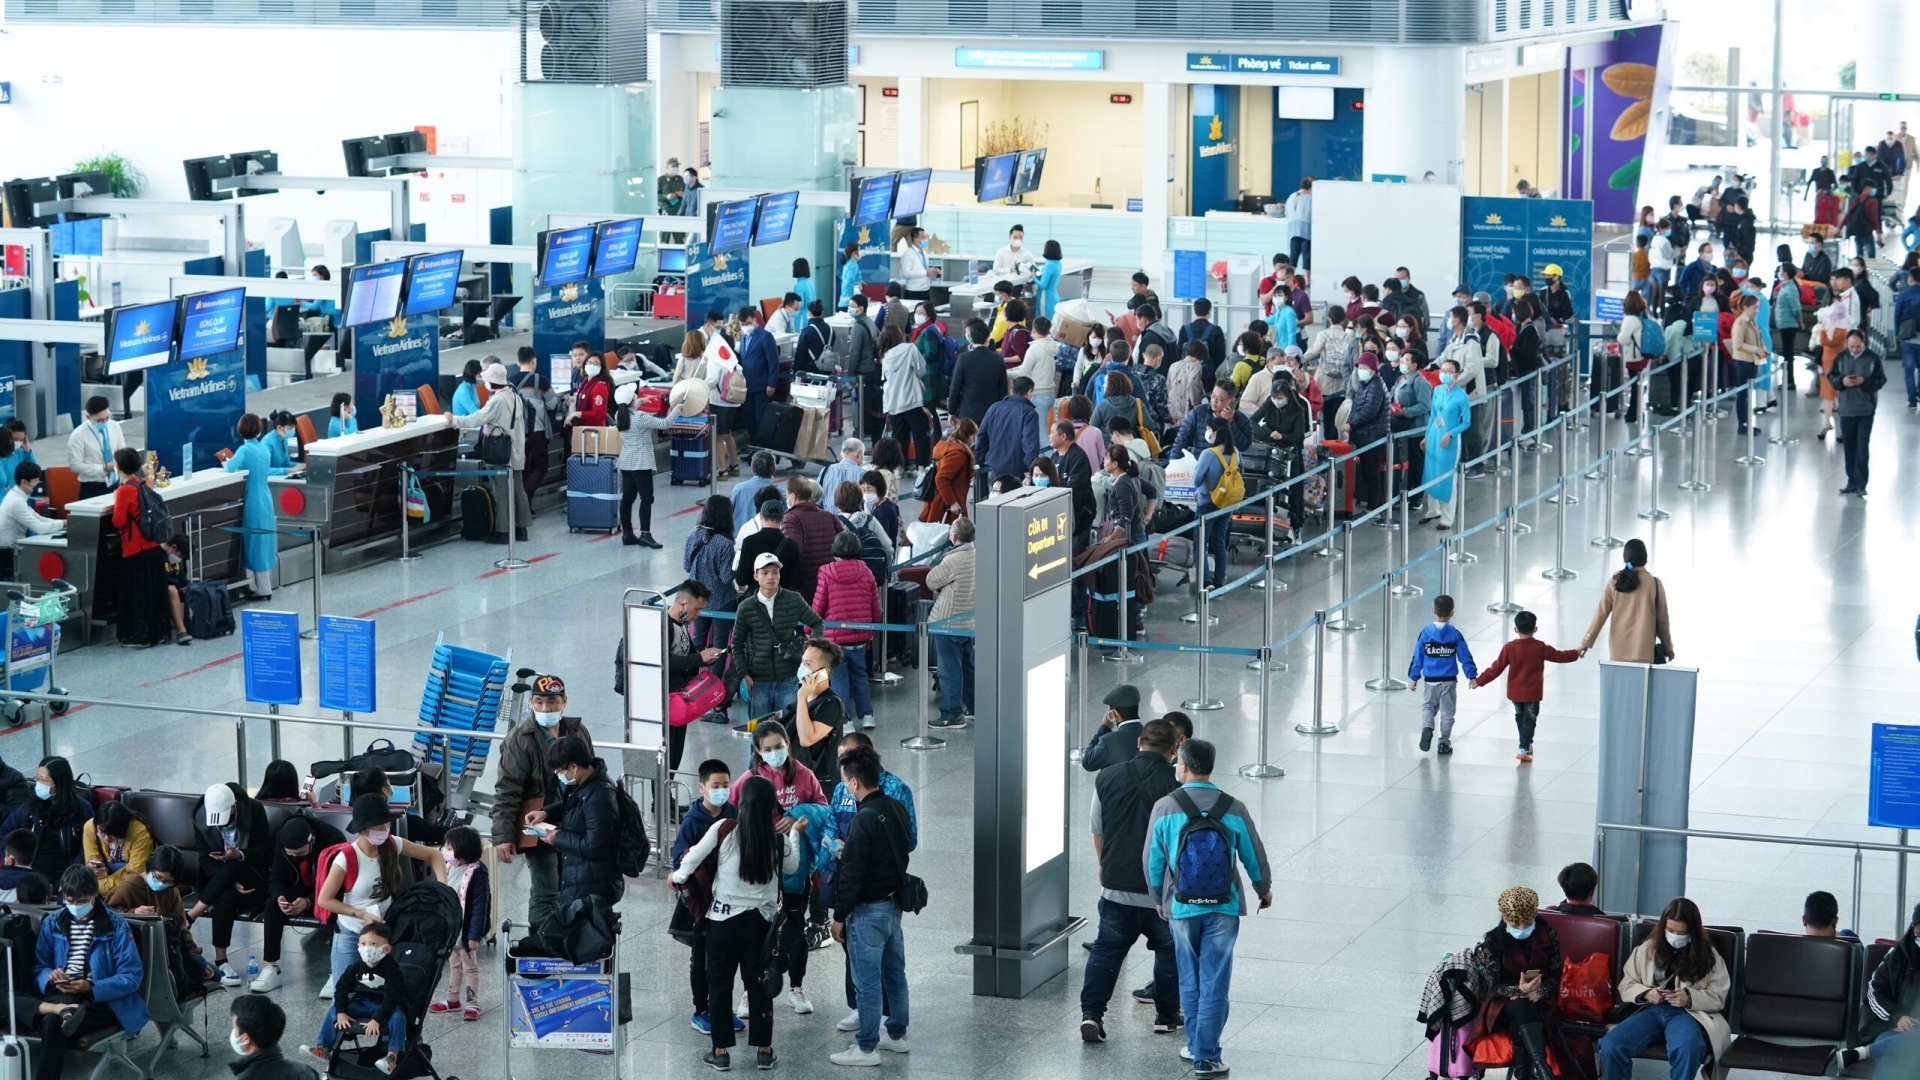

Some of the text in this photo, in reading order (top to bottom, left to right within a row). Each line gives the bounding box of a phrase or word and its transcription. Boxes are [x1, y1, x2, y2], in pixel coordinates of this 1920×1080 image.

[1238, 57, 1282, 71] Phòng vé
[1288, 61, 1331, 71] Ticket office
[195, 325, 227, 339] Position Closed
[1028, 517, 1041, 536] CỬA
[1028, 535, 1055, 555] Departure
[712, 900, 731, 915] ER
[531, 1006, 540, 1014] ONE
[554, 995, 572, 1006] LEADING
[533, 1011, 548, 1019] TEXTILE
[557, 1002, 575, 1012] GARMENT
[575, 990, 607, 1006] MANUFACTURERS
